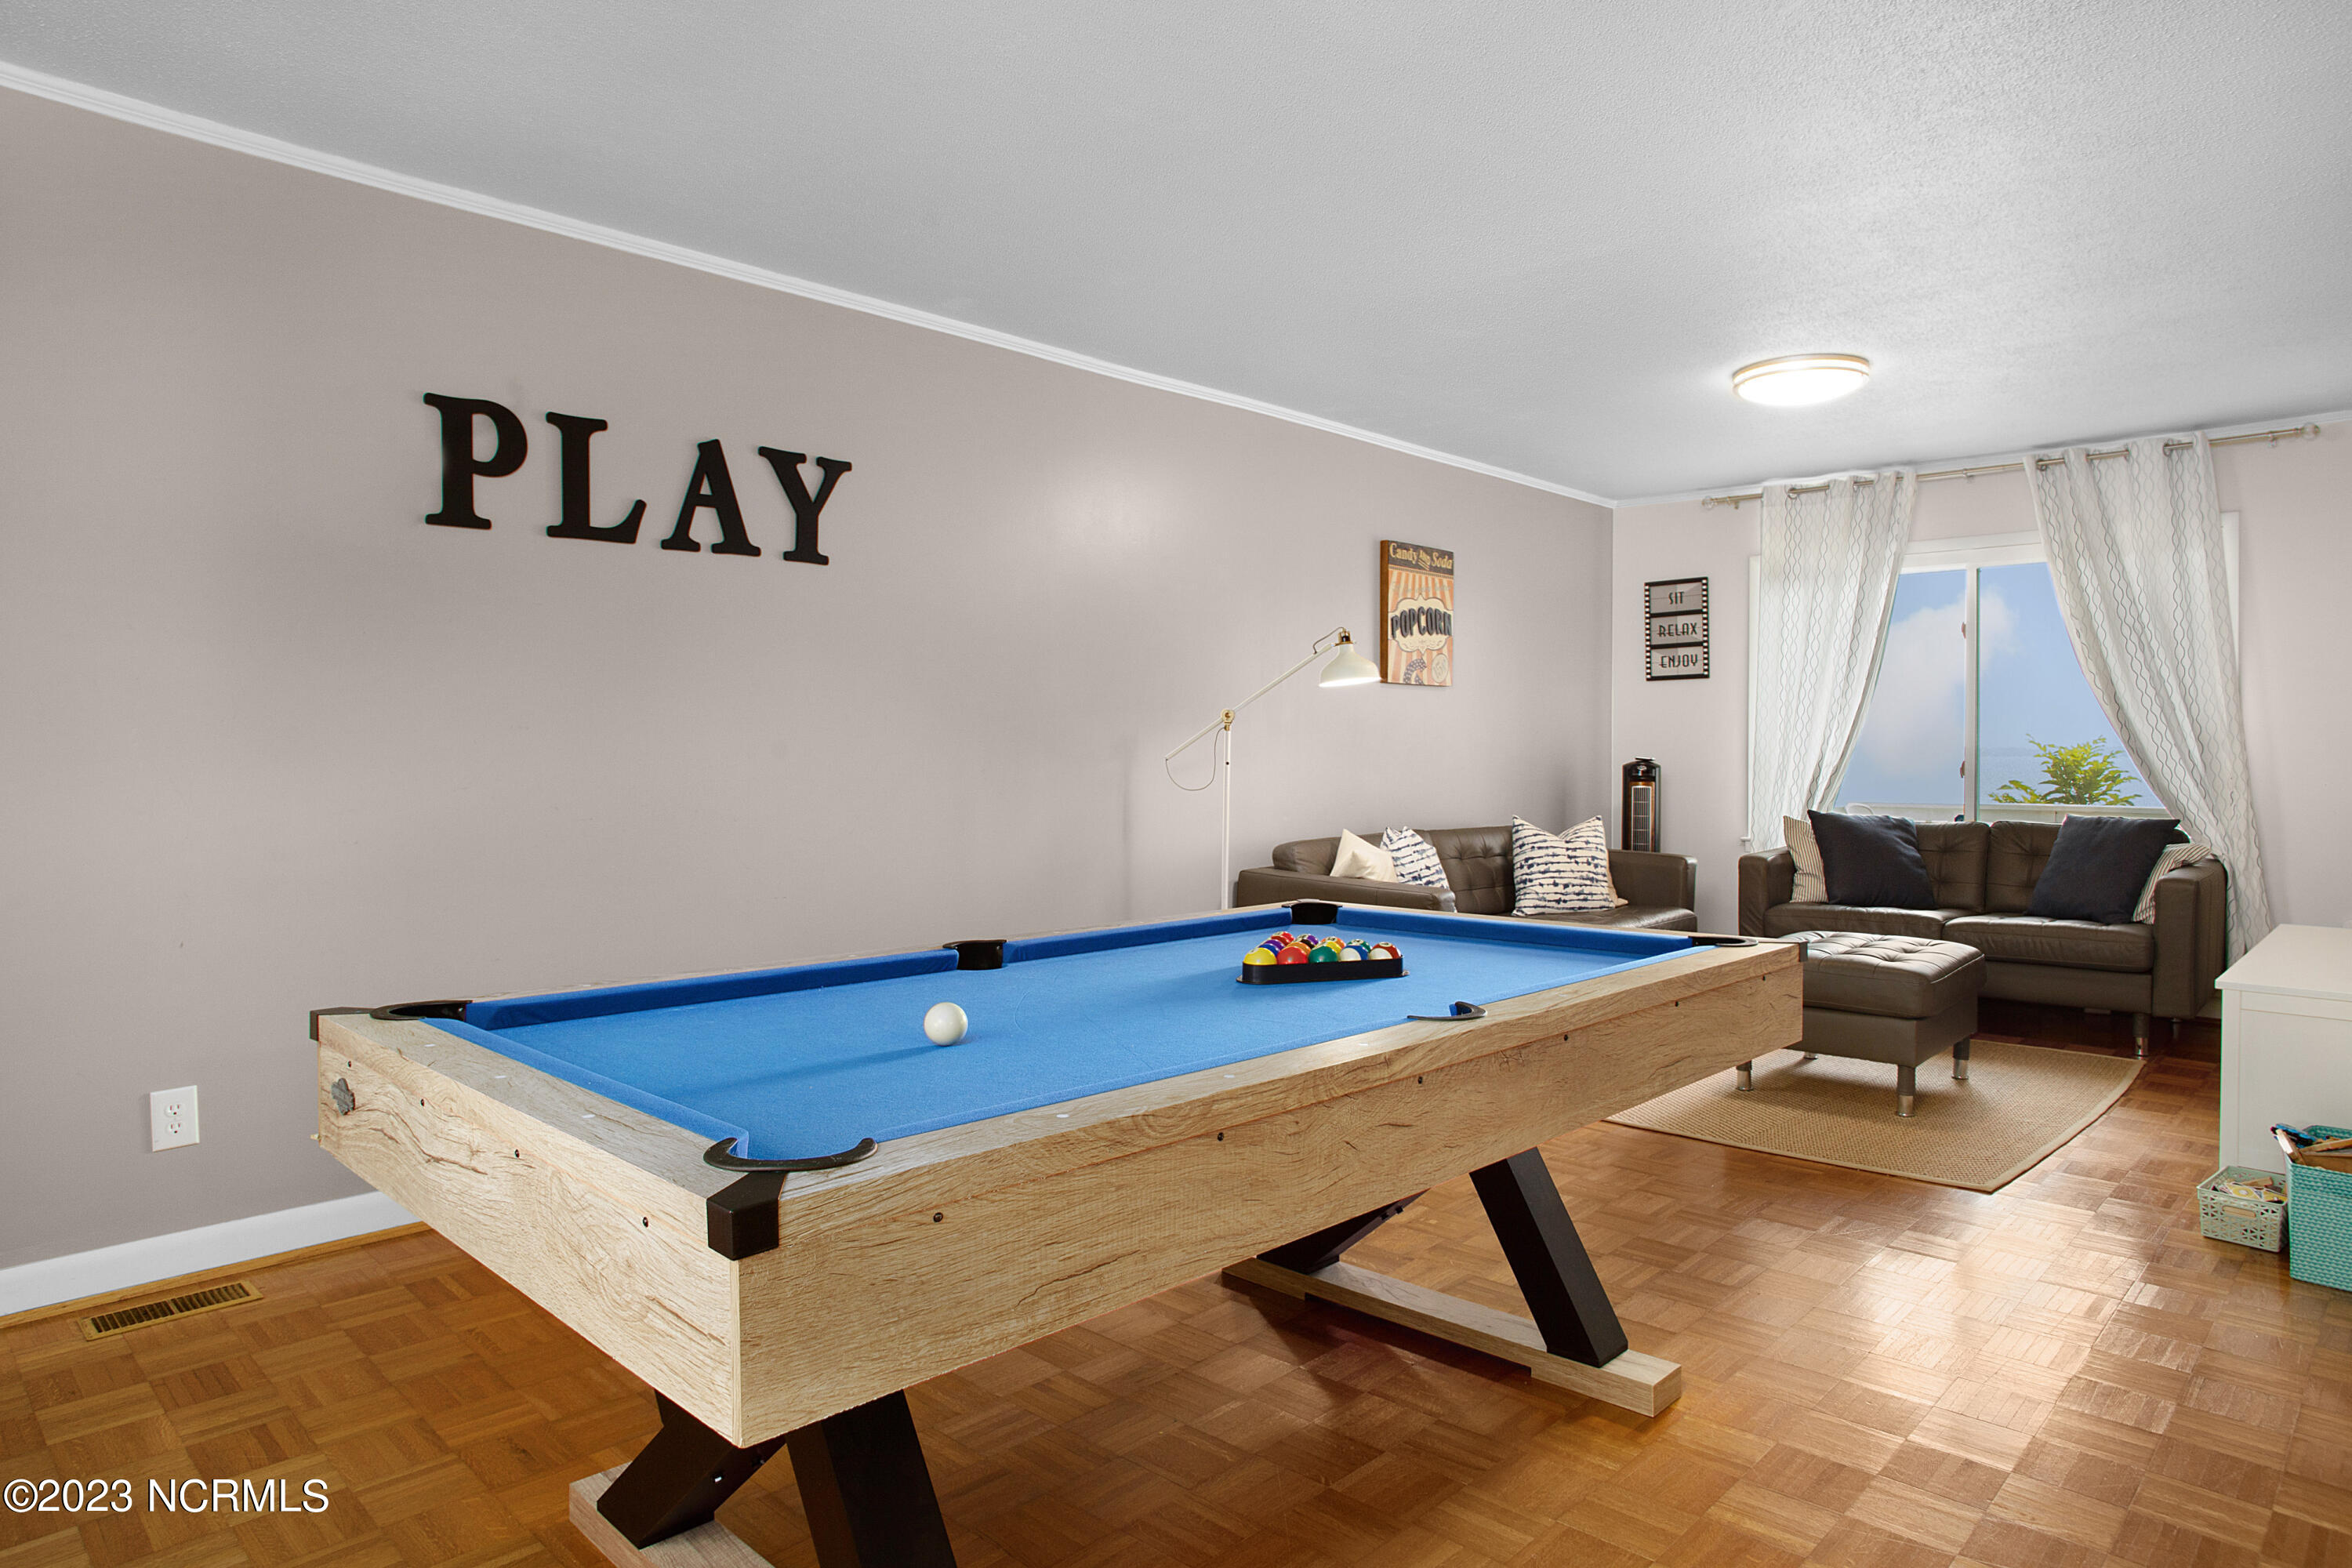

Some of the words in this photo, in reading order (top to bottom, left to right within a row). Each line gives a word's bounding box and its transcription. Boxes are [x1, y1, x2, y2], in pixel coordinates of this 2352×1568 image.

[423, 392, 852, 565] PLAY
[1390, 543, 1417, 564] Candy
[1432, 552, 1453, 569] Soda
[1668, 591, 1684, 604] SIT
[1391, 606, 1452, 640] POPCORN
[1657, 622, 1697, 637] RELAX
[1659, 654, 1697, 668] ENJOY
